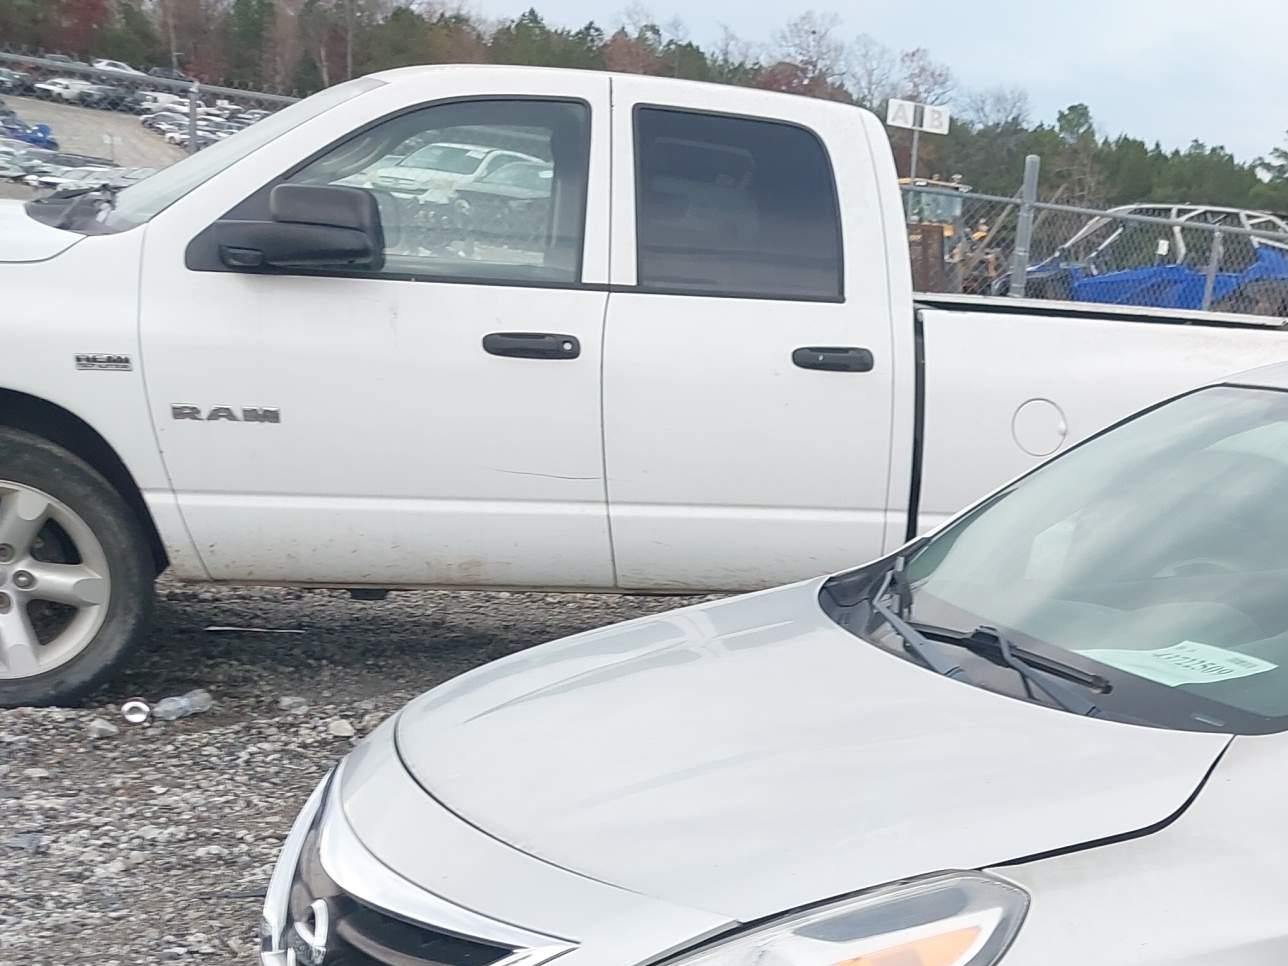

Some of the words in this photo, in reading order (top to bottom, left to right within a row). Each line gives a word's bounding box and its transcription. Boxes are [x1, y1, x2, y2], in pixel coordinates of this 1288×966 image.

[891, 103, 909, 124] A
[929, 110, 943, 129] B
[171, 404, 280, 423] RAM
